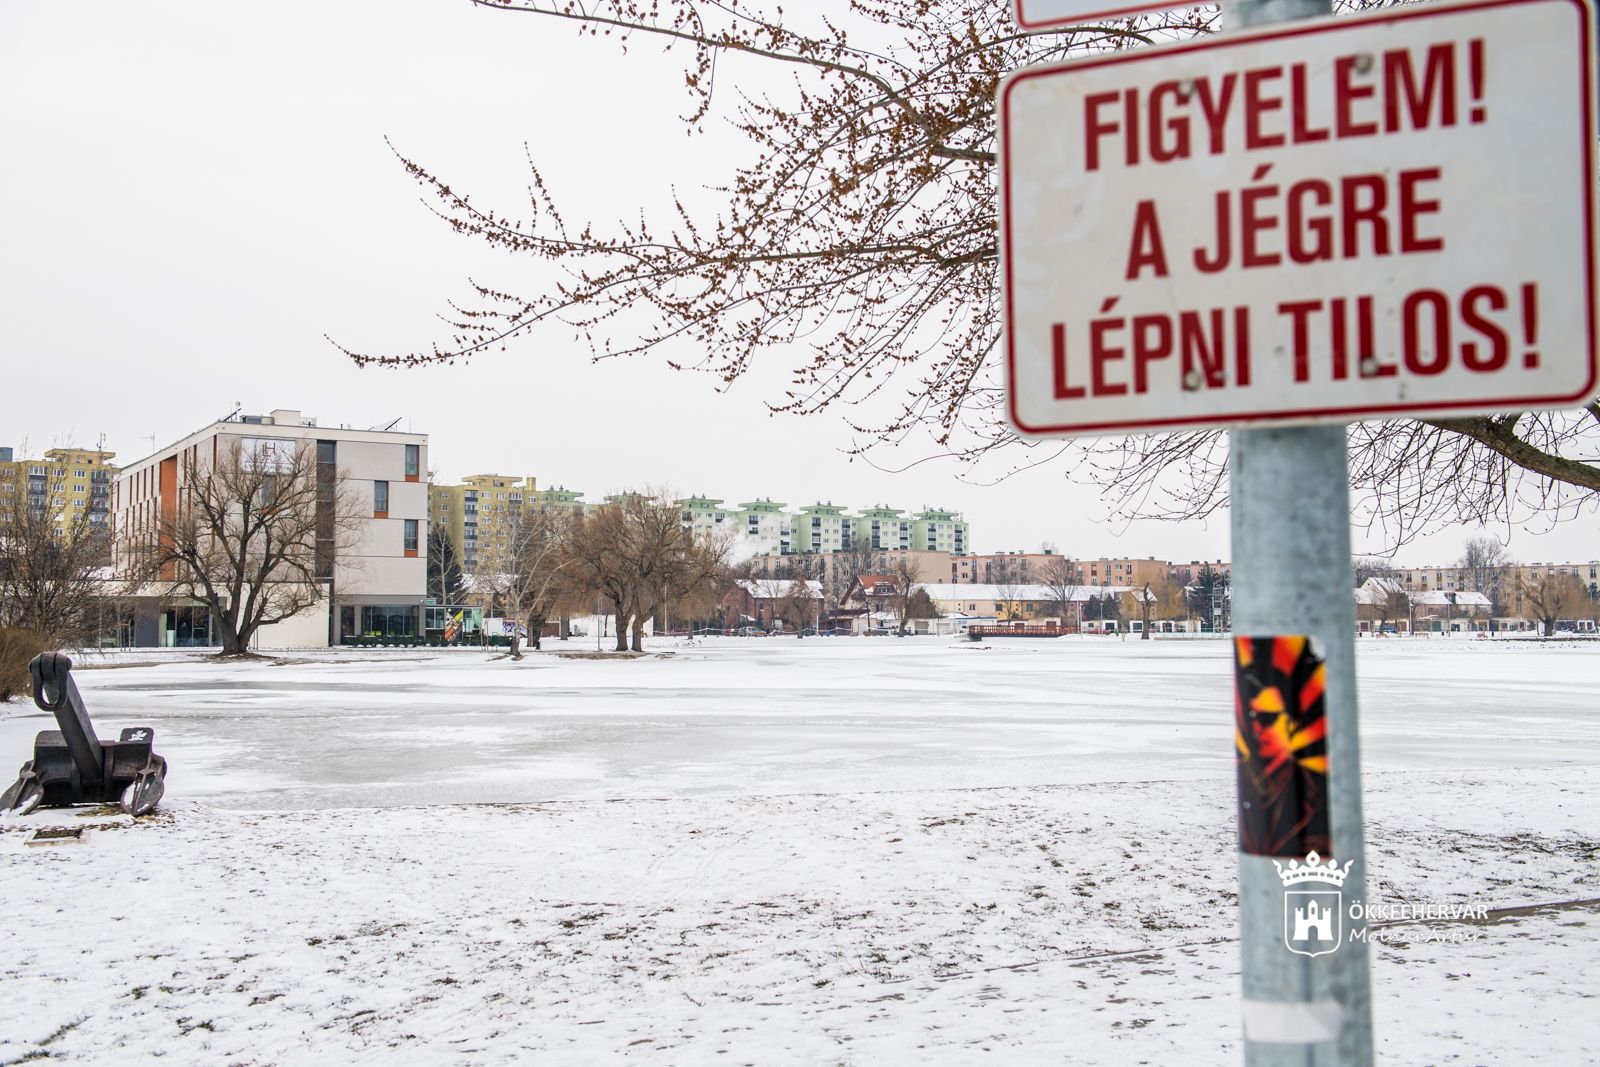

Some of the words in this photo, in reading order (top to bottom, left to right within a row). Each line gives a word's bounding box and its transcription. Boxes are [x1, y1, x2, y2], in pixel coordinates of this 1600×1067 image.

[1083, 38, 1486, 172] FIGYELEM!
[1124, 199, 1170, 281] A
[1192, 163, 1444, 274] JÉGRE
[1051, 296, 1252, 401] LÉPNI
[1277, 282, 1541, 384] TILOS!
